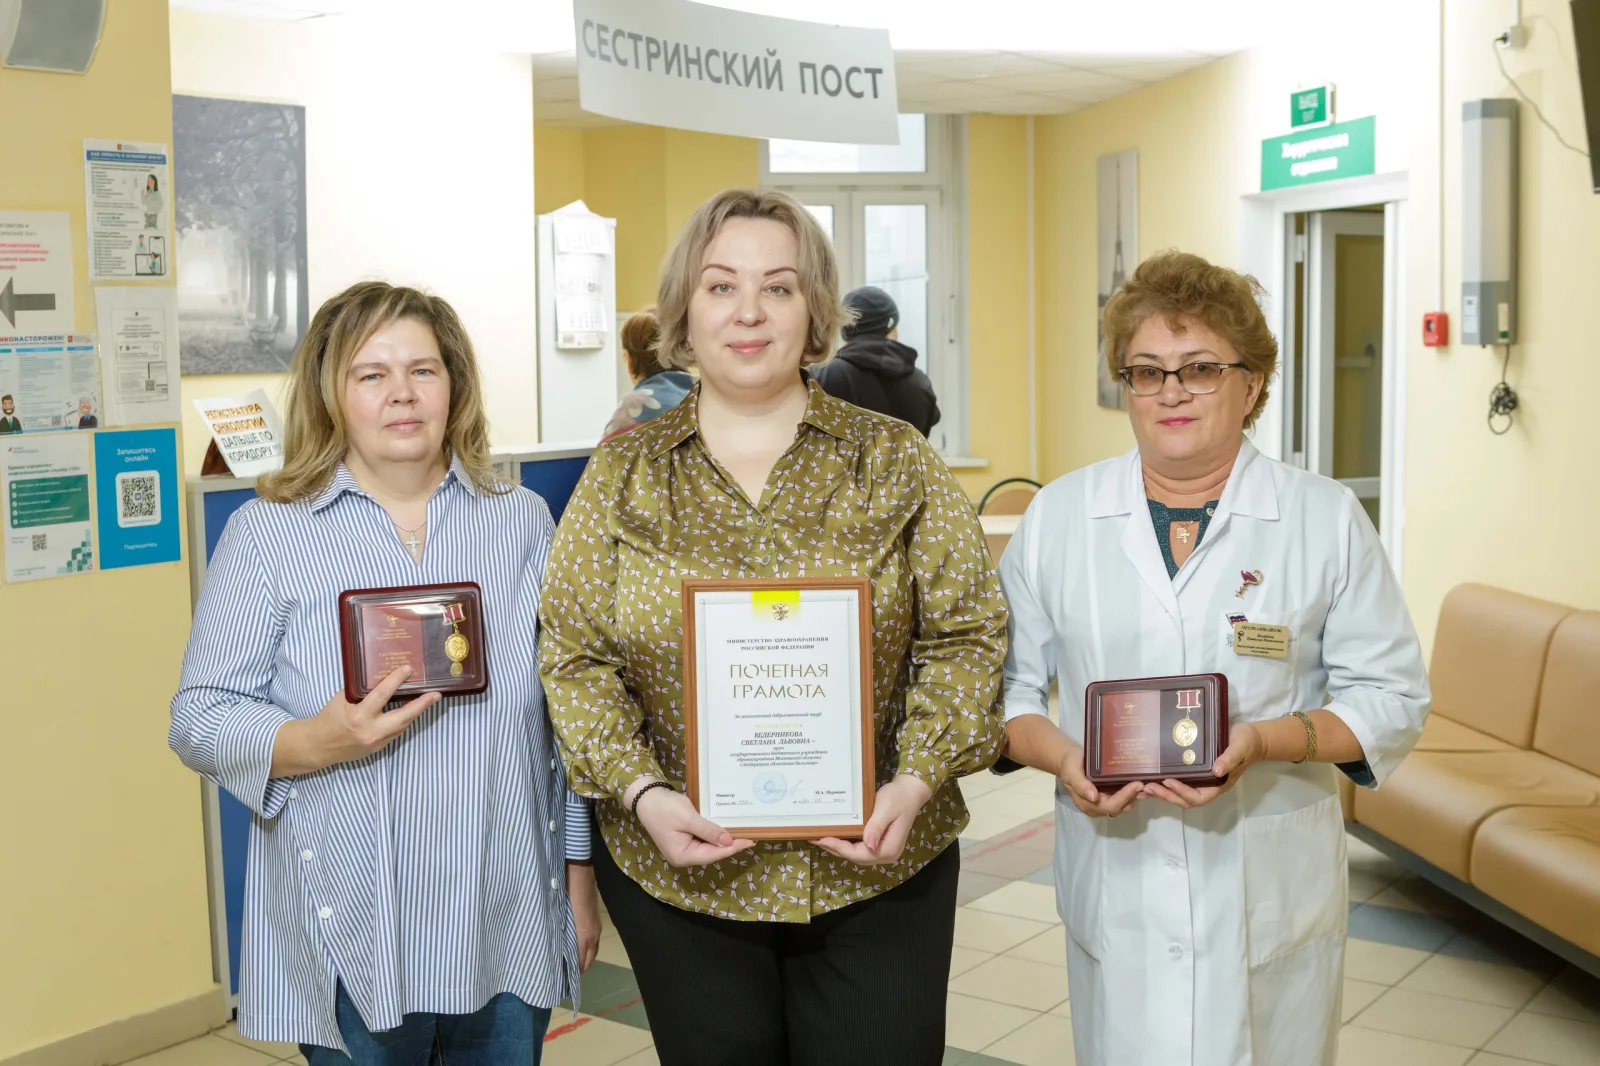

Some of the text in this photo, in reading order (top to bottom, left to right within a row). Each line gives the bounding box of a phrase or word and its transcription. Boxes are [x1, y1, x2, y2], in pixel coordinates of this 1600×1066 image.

[582, 19, 883, 99] СЕСТРИНСКИЙ ПОСТ
[205, 404, 263, 420] РЕГИСТРАТУРА
[212, 416, 266, 434] ОНКОЛОГИИ
[221, 431, 273, 448] ДАЛЬШЕ ПО
[117, 448, 156, 456] Запишитесь
[125, 455, 148, 463] онлайн
[227, 446, 272, 461] КОРИДОРУ
[730, 663, 828, 678] ПОЧЕТНАЯ
[733, 684, 826, 698] ГРАМОТА
[754, 731, 803, 739] ВЕДЕРНИКОВА
